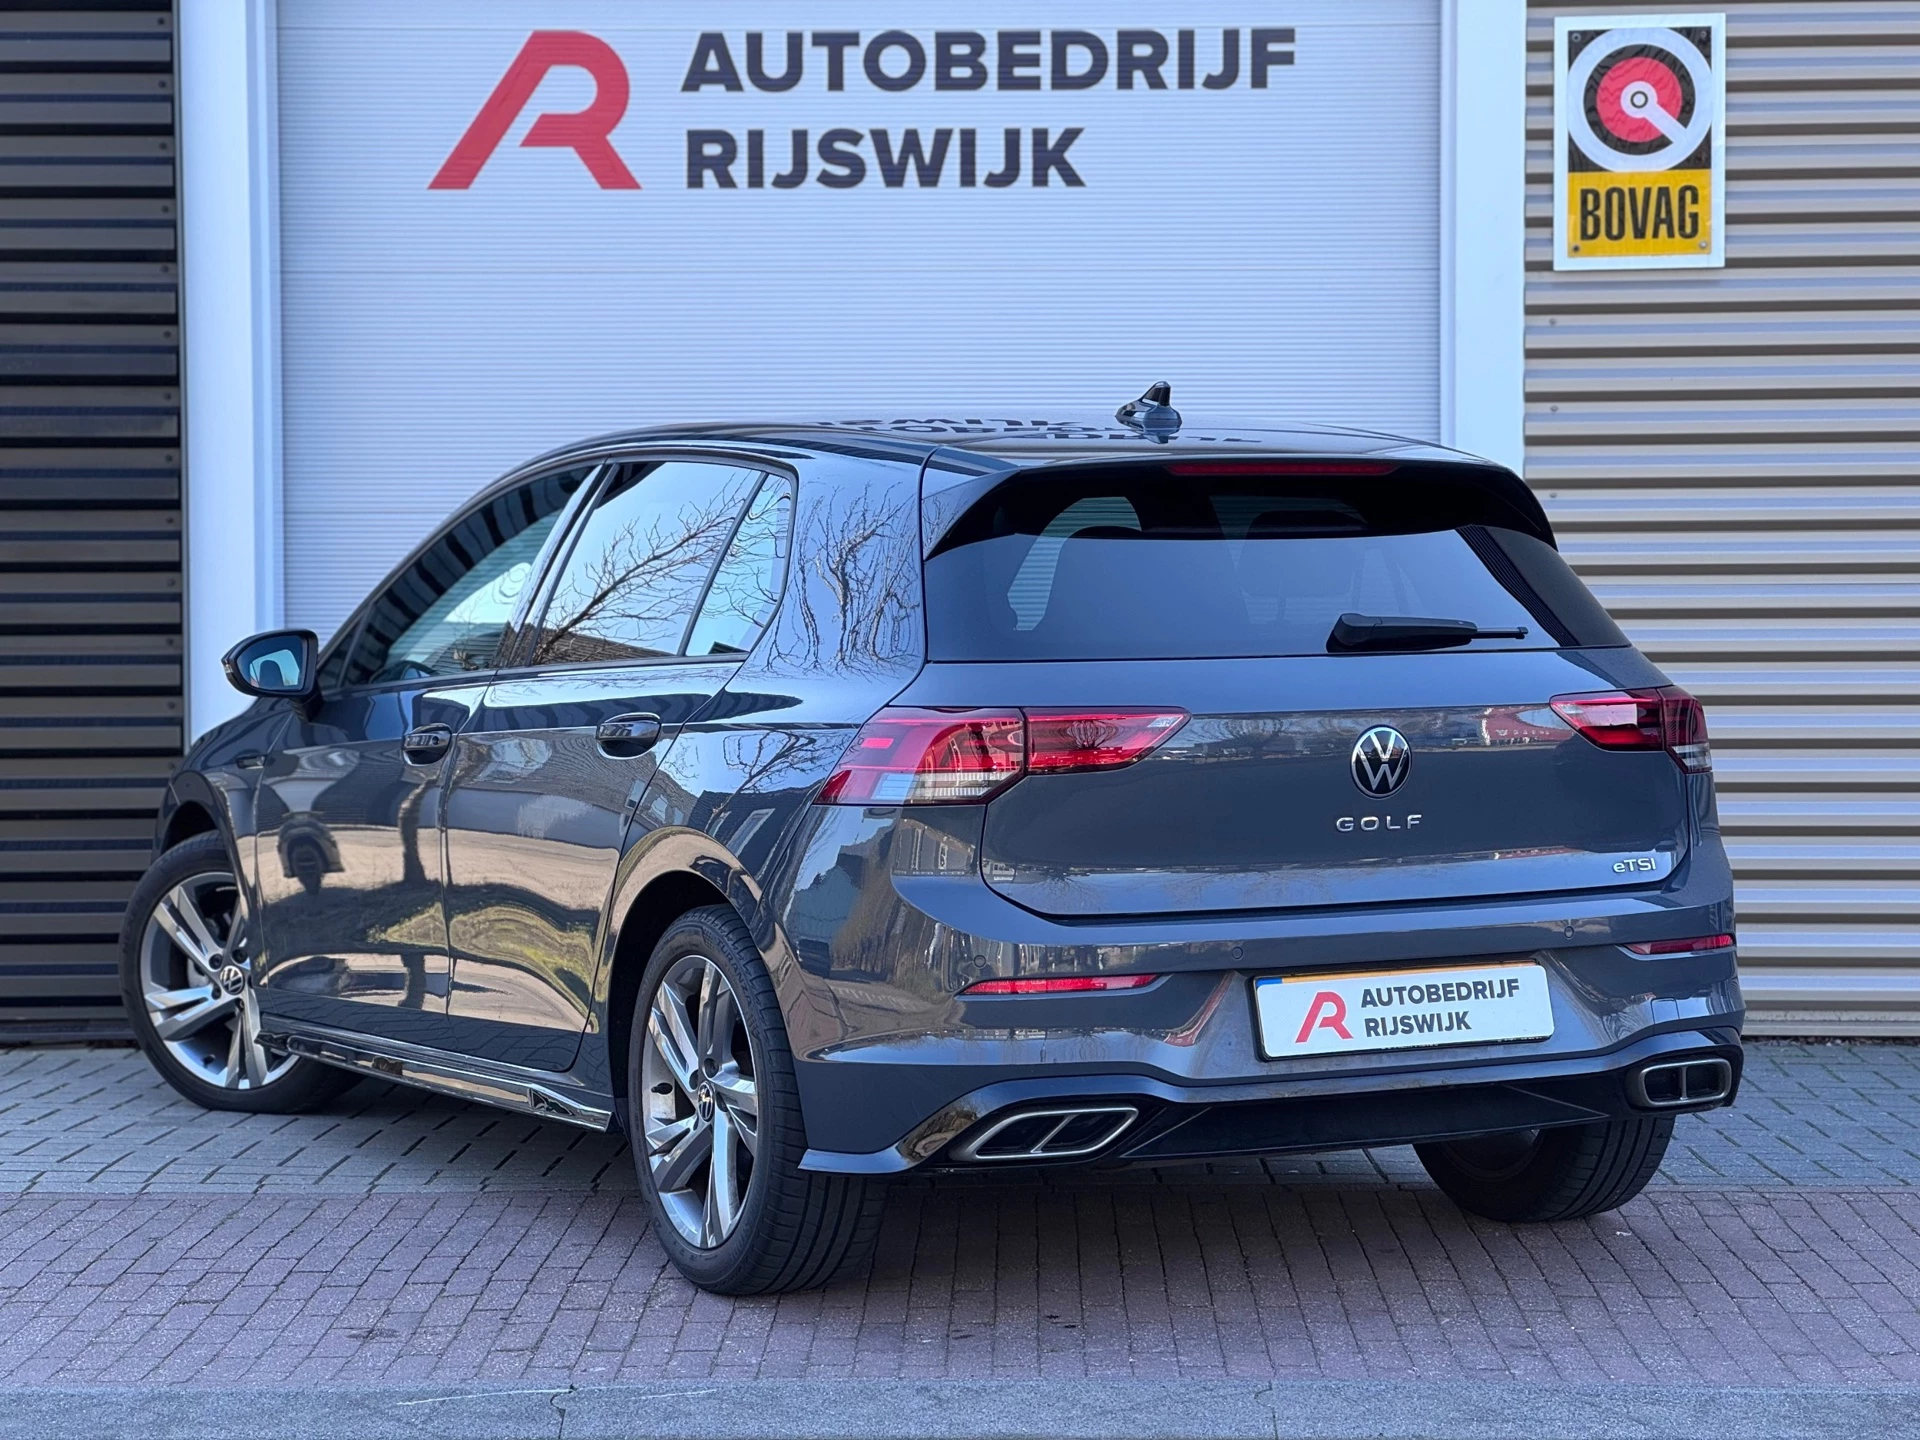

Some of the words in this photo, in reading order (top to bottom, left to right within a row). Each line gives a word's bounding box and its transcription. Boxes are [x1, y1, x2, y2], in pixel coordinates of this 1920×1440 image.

[681, 28, 1295, 92] AUTOBEDRIJF
[686, 128, 1086, 190] RIJSWIJK
[1580, 185, 1699, 241] BOVAG
[1335, 814, 1422, 832] GOLF
[1613, 857, 1657, 873] eTSI
[716, 937, 753, 1007] TURANZA
[1361, 978, 1520, 1008] AUTOBEDRIJF
[1364, 1011, 1473, 1038] RIJSWIJK
